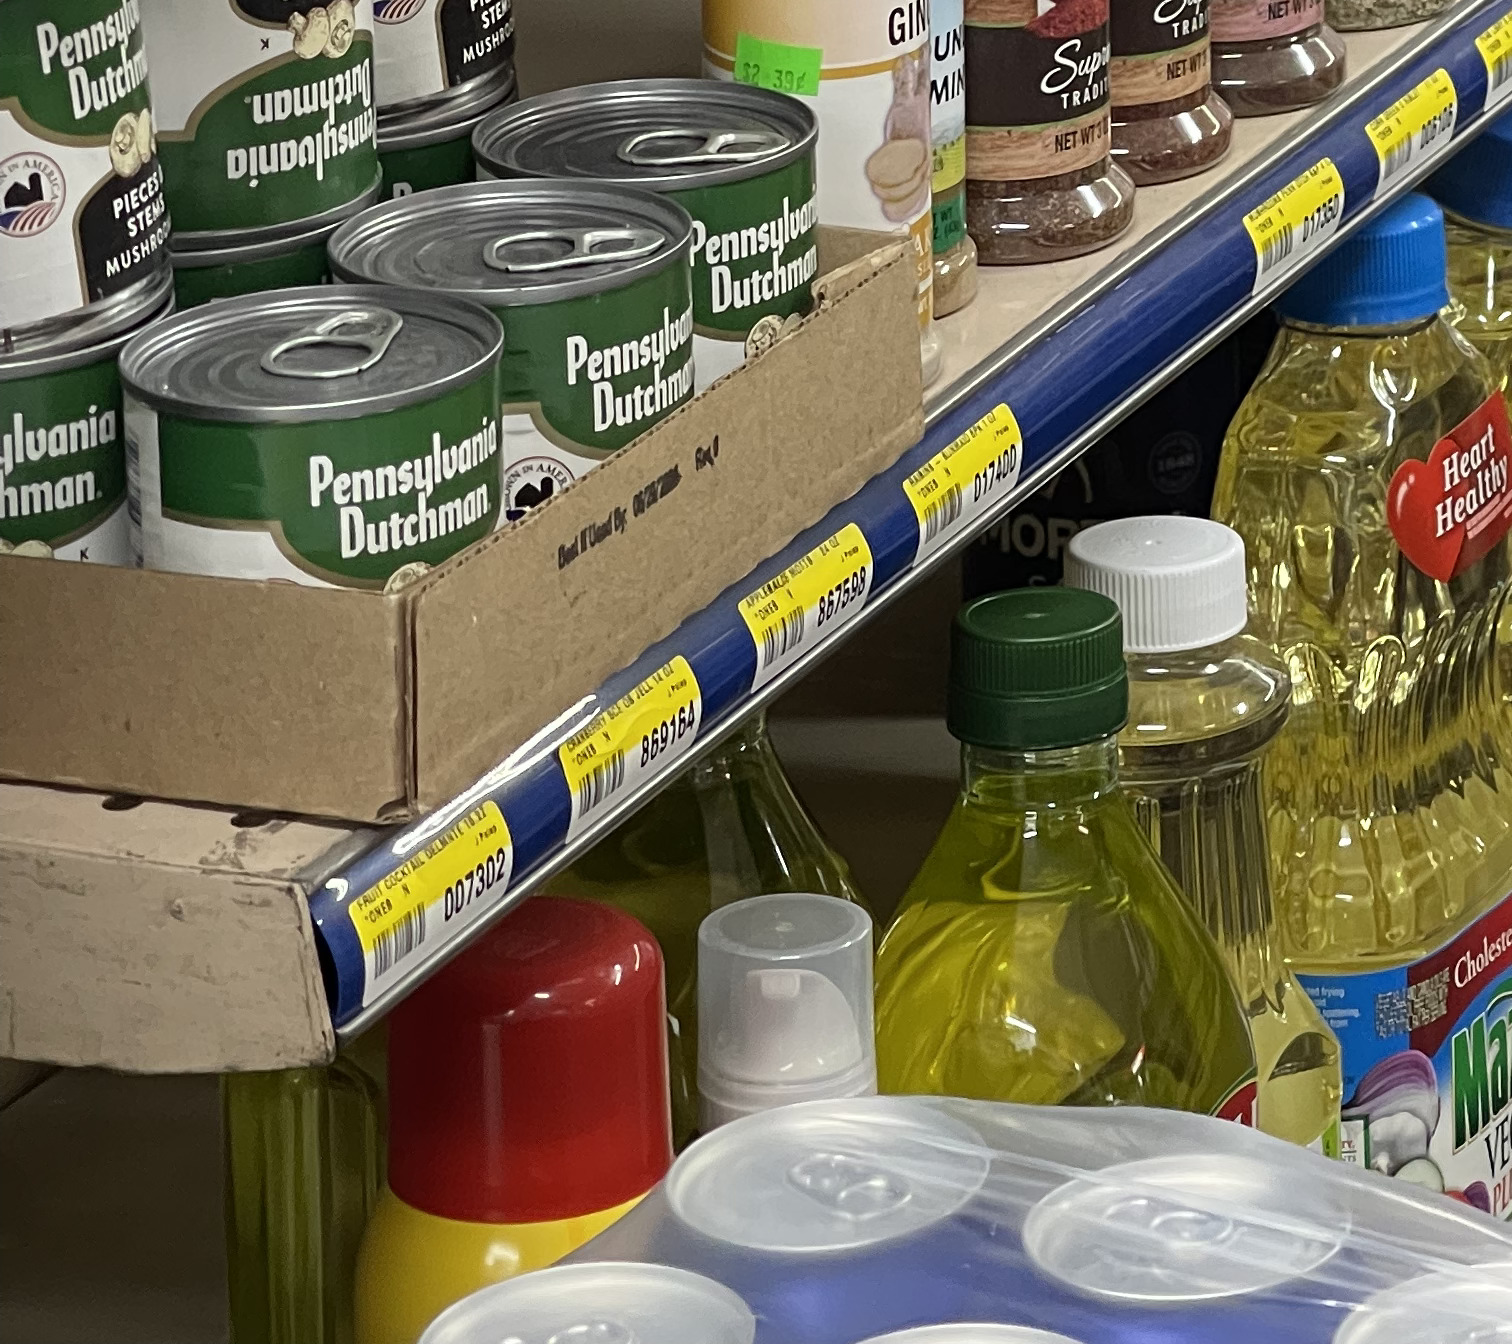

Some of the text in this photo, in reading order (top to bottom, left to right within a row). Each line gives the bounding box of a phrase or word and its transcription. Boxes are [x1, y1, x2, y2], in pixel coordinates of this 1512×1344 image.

[113, 178, 159, 217] PIECES
[310, 417, 497, 509] Pennsylvania
[973, 443, 1017, 503] 017400
[1444, 423, 1495, 489] Heart
[1435, 457, 1509, 540] Healthy
[817, 566, 866, 627] 867598
[640, 700, 695, 768] 869164
[444, 847, 506, 922] 007302
